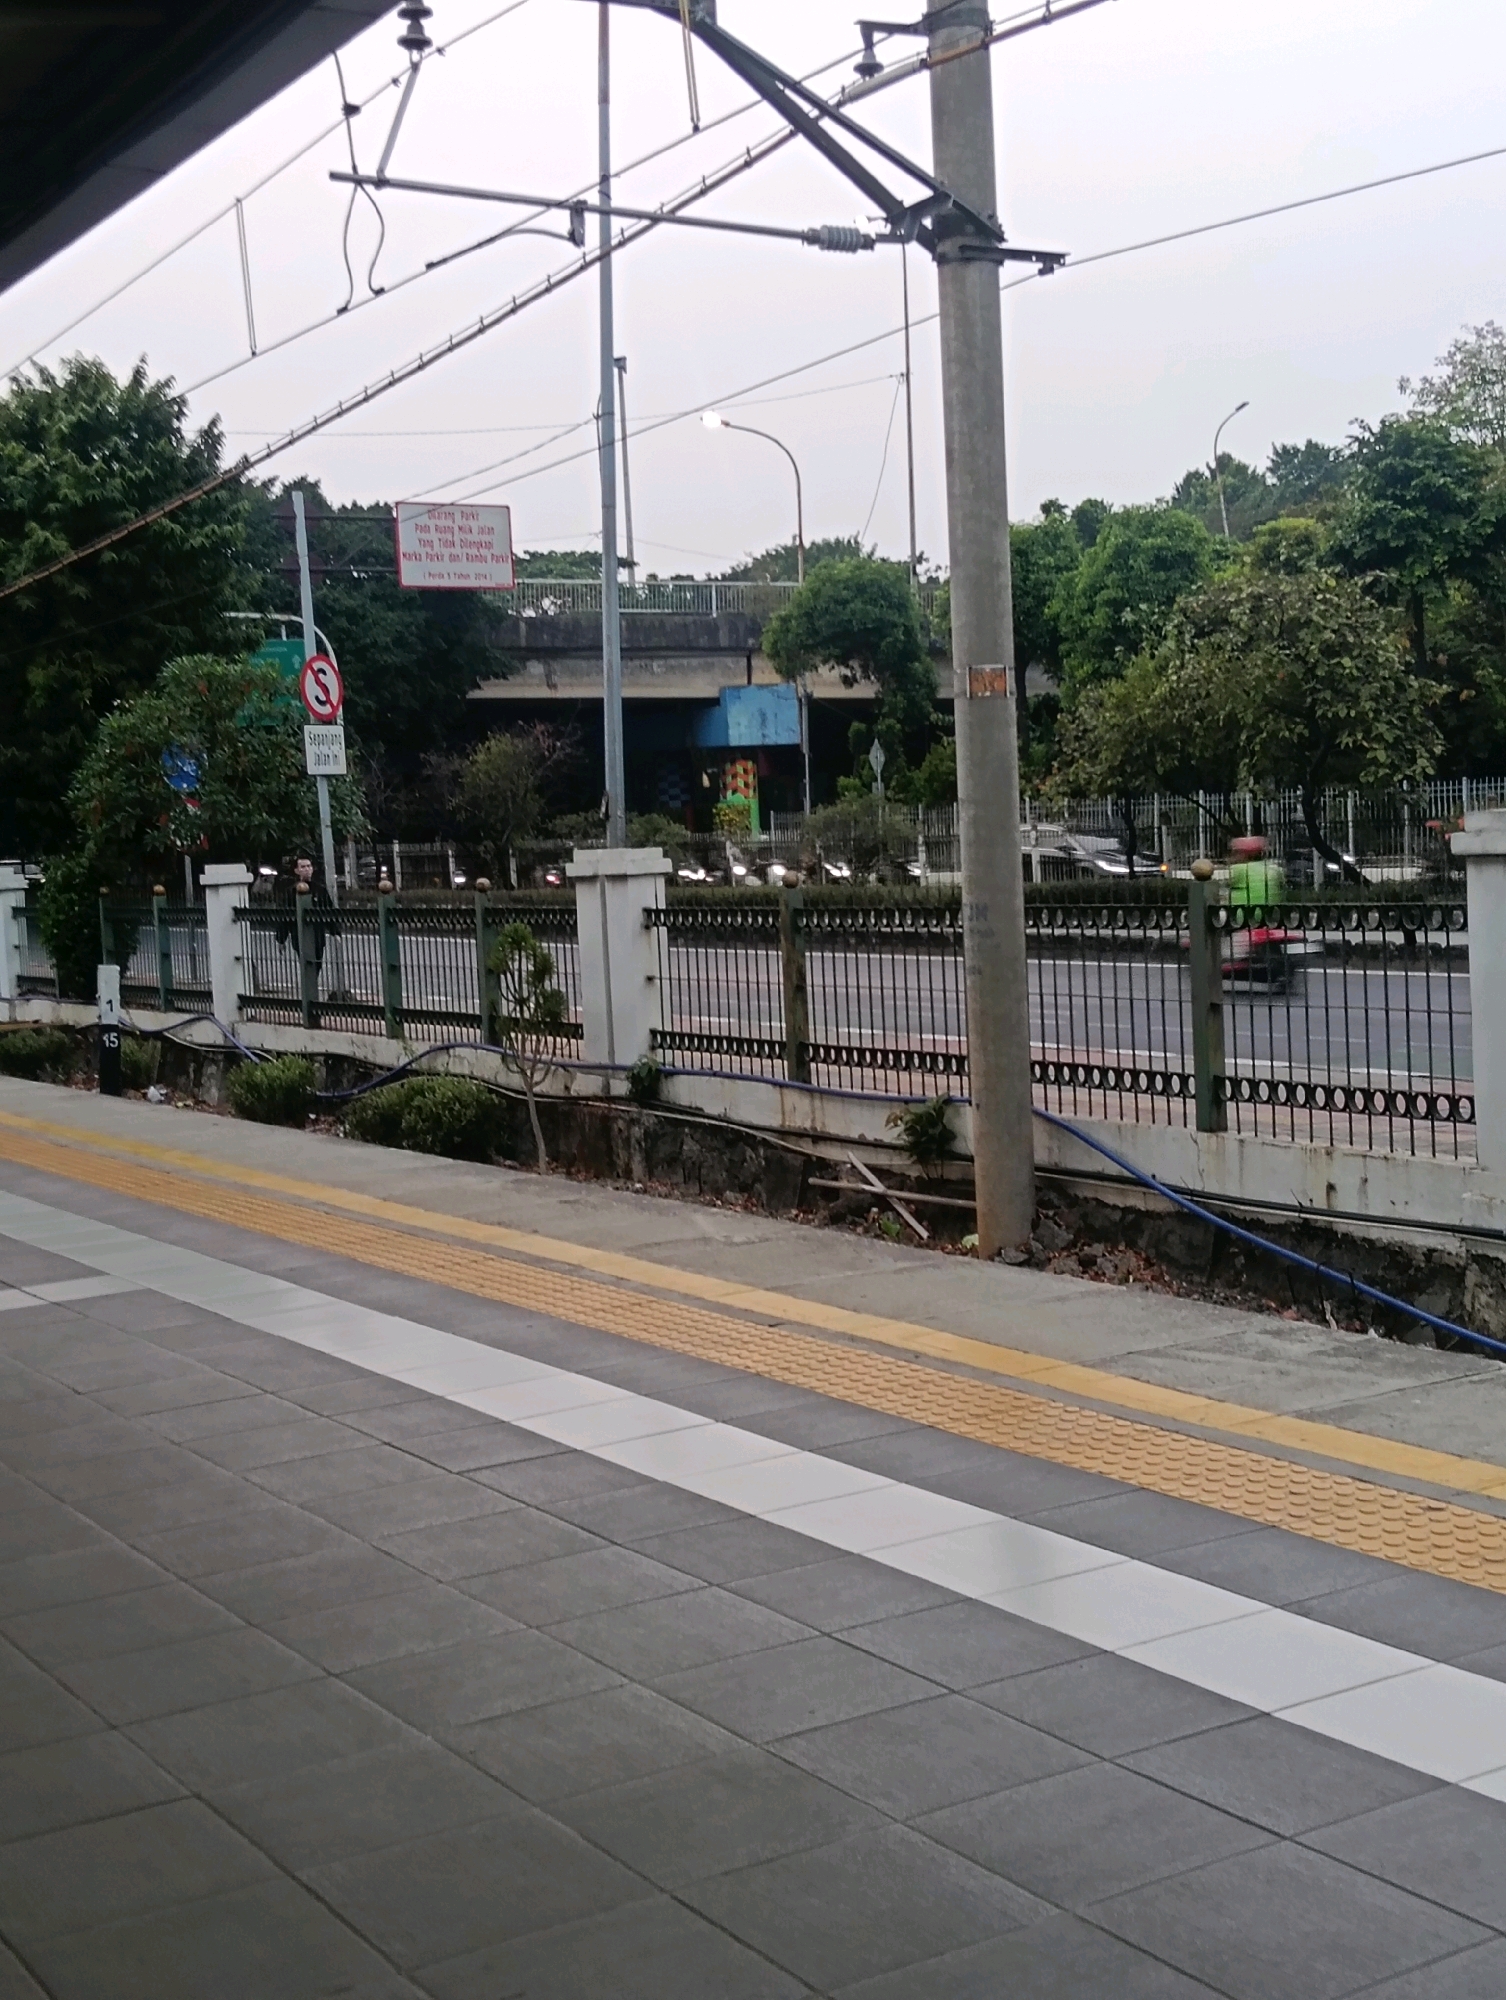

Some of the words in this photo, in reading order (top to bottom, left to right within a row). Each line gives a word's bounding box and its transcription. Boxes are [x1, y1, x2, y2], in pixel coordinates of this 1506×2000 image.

[428, 510, 455, 523] Dilarang
[461, 510, 480, 521] Parkir
[415, 523, 431, 533] Pada
[435, 524, 454, 537] Ruang
[458, 525, 473, 535] Milik
[478, 526, 495, 535] Jalan
[418, 538, 434, 552] Yang
[438, 538, 455, 549] Tidak
[460, 538, 494, 552] Dilengkapi
[402, 552, 422, 562] Marka
[426, 552, 444, 562] Parkir
[466, 552, 487, 564] Rambu
[491, 553, 509, 564] Parkir
[308, 731, 342, 751] Sepanjang
[314, 752, 331, 767] Jalan
[106, 999, 113, 1012] 1
[103, 1032, 119, 1048] 15
